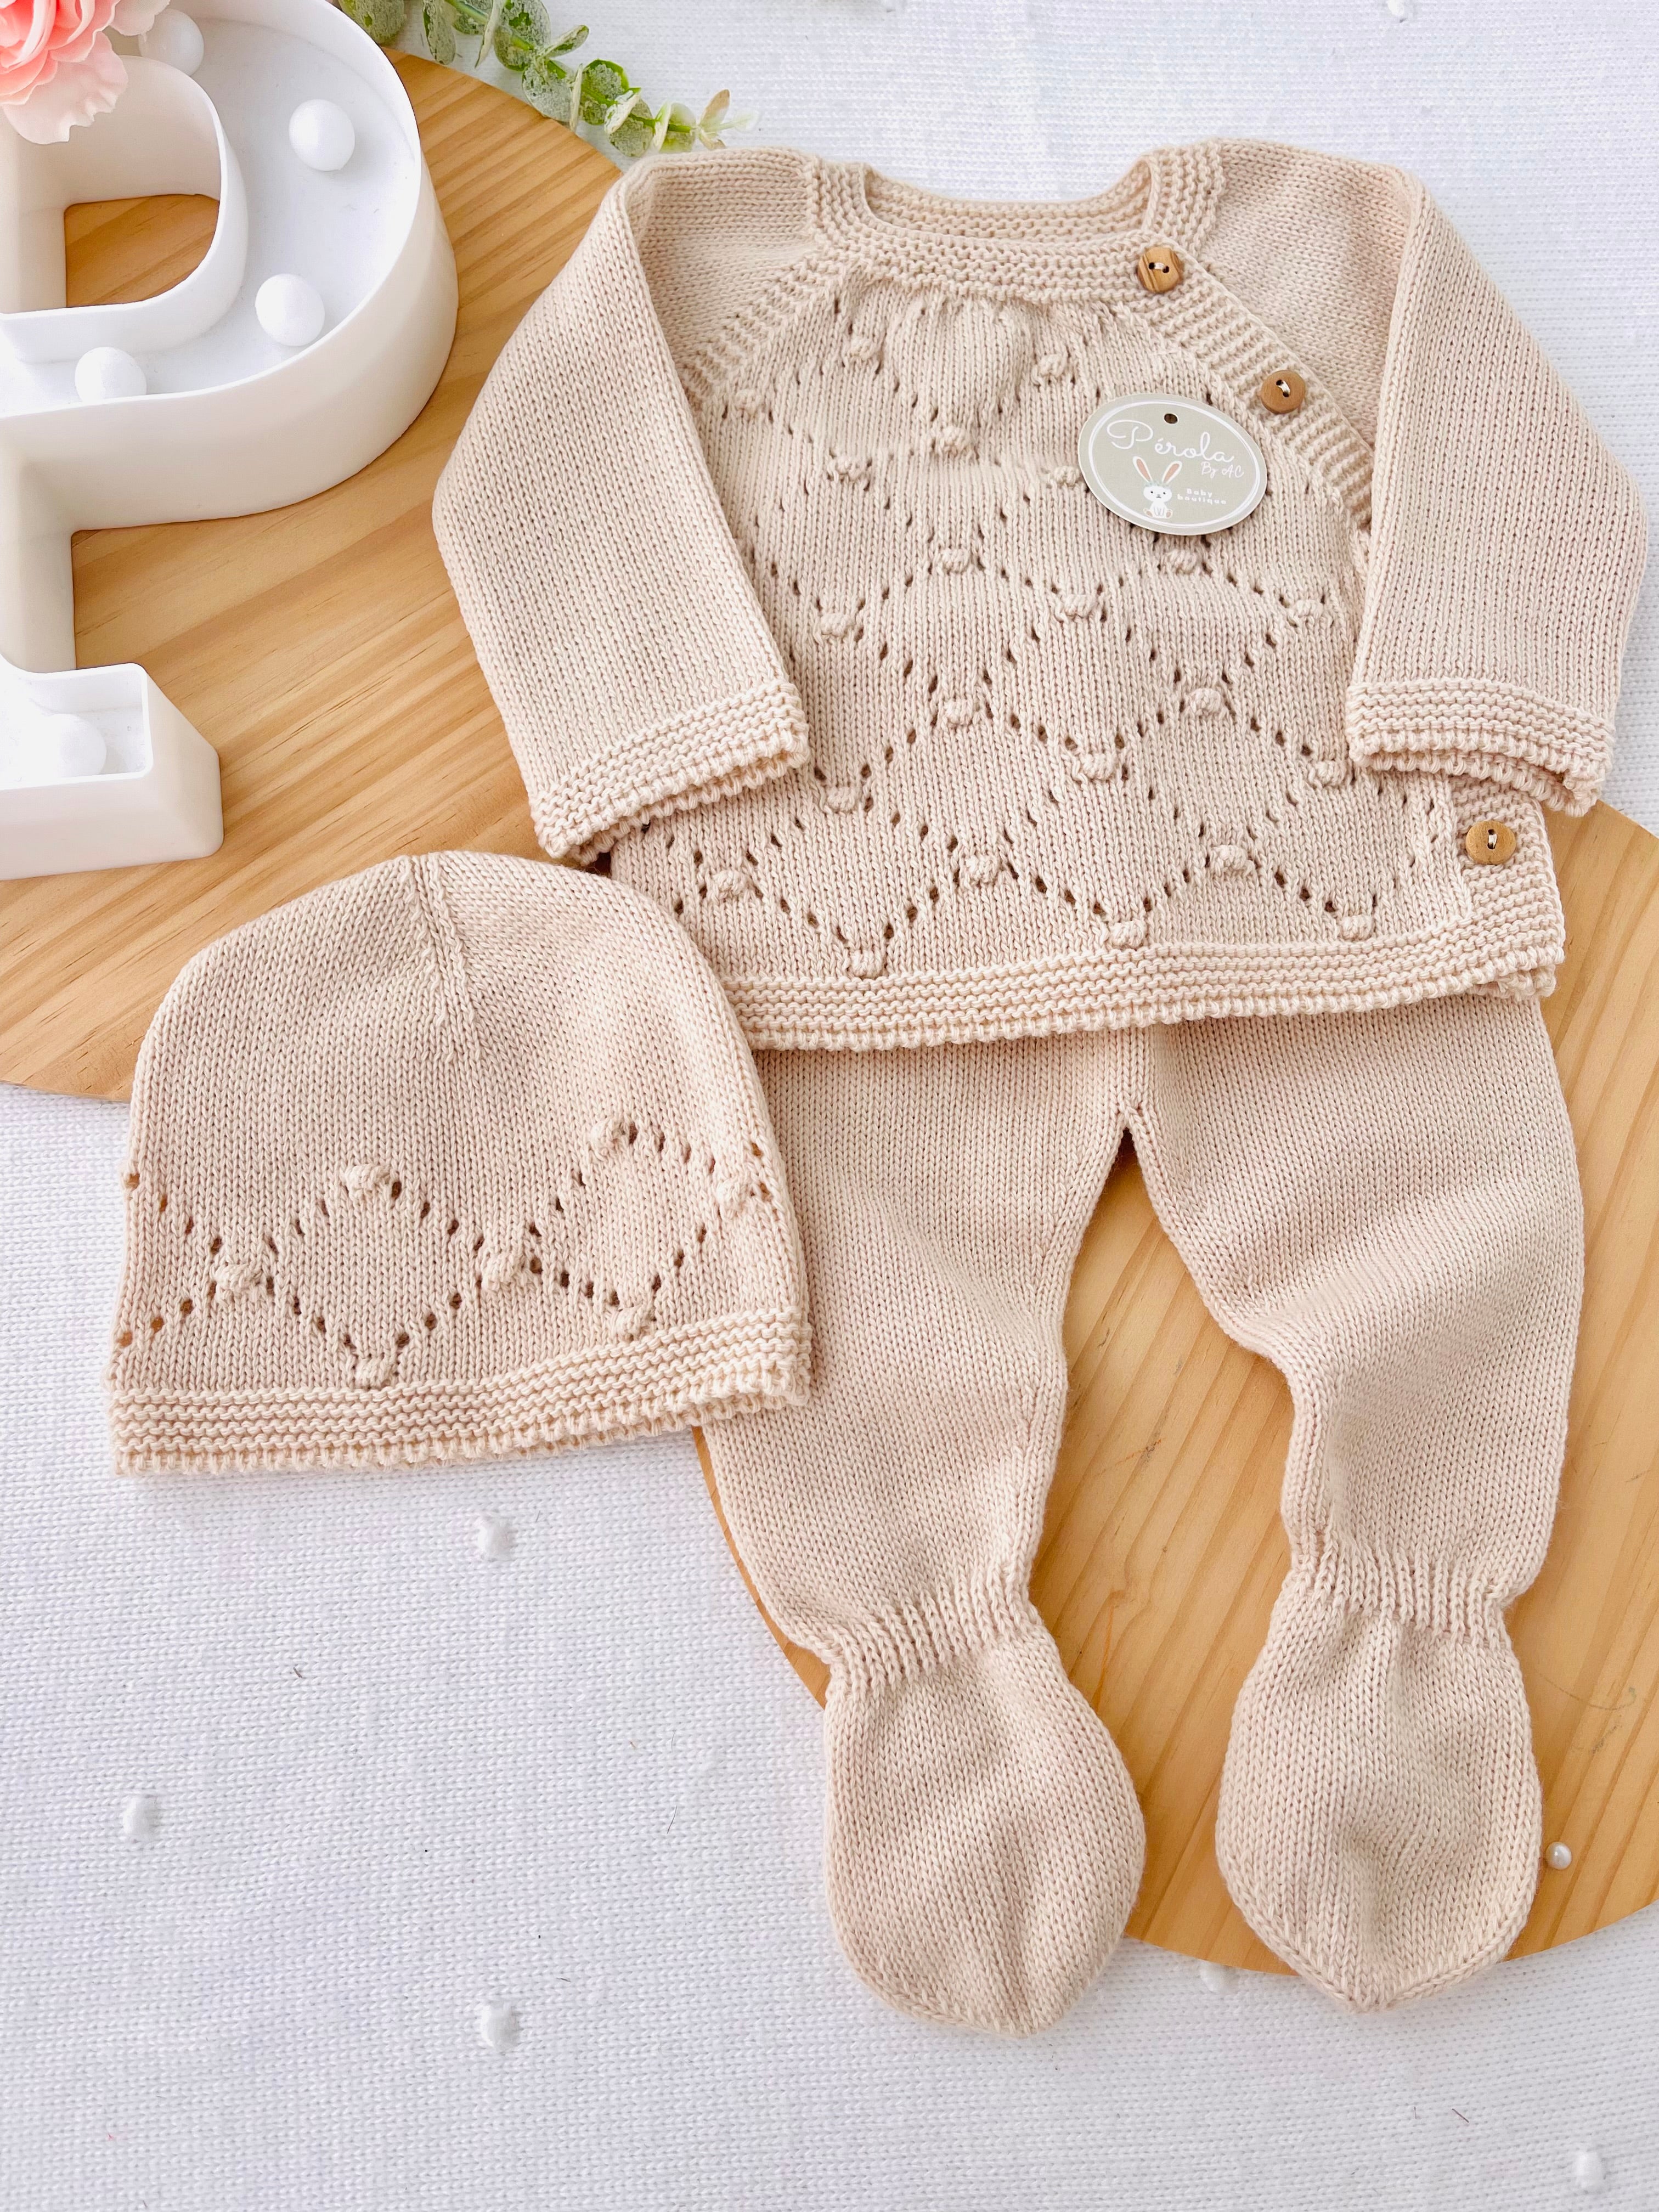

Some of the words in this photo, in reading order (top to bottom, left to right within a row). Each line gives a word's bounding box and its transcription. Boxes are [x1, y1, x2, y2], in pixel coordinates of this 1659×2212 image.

[1106, 419, 1234, 462] Pérola
[1200, 461, 1217, 479] By
[1221, 464, 1245, 478] AC
[1177, 493, 1227, 505] boutique
[1187, 488, 1212, 498] Baby
